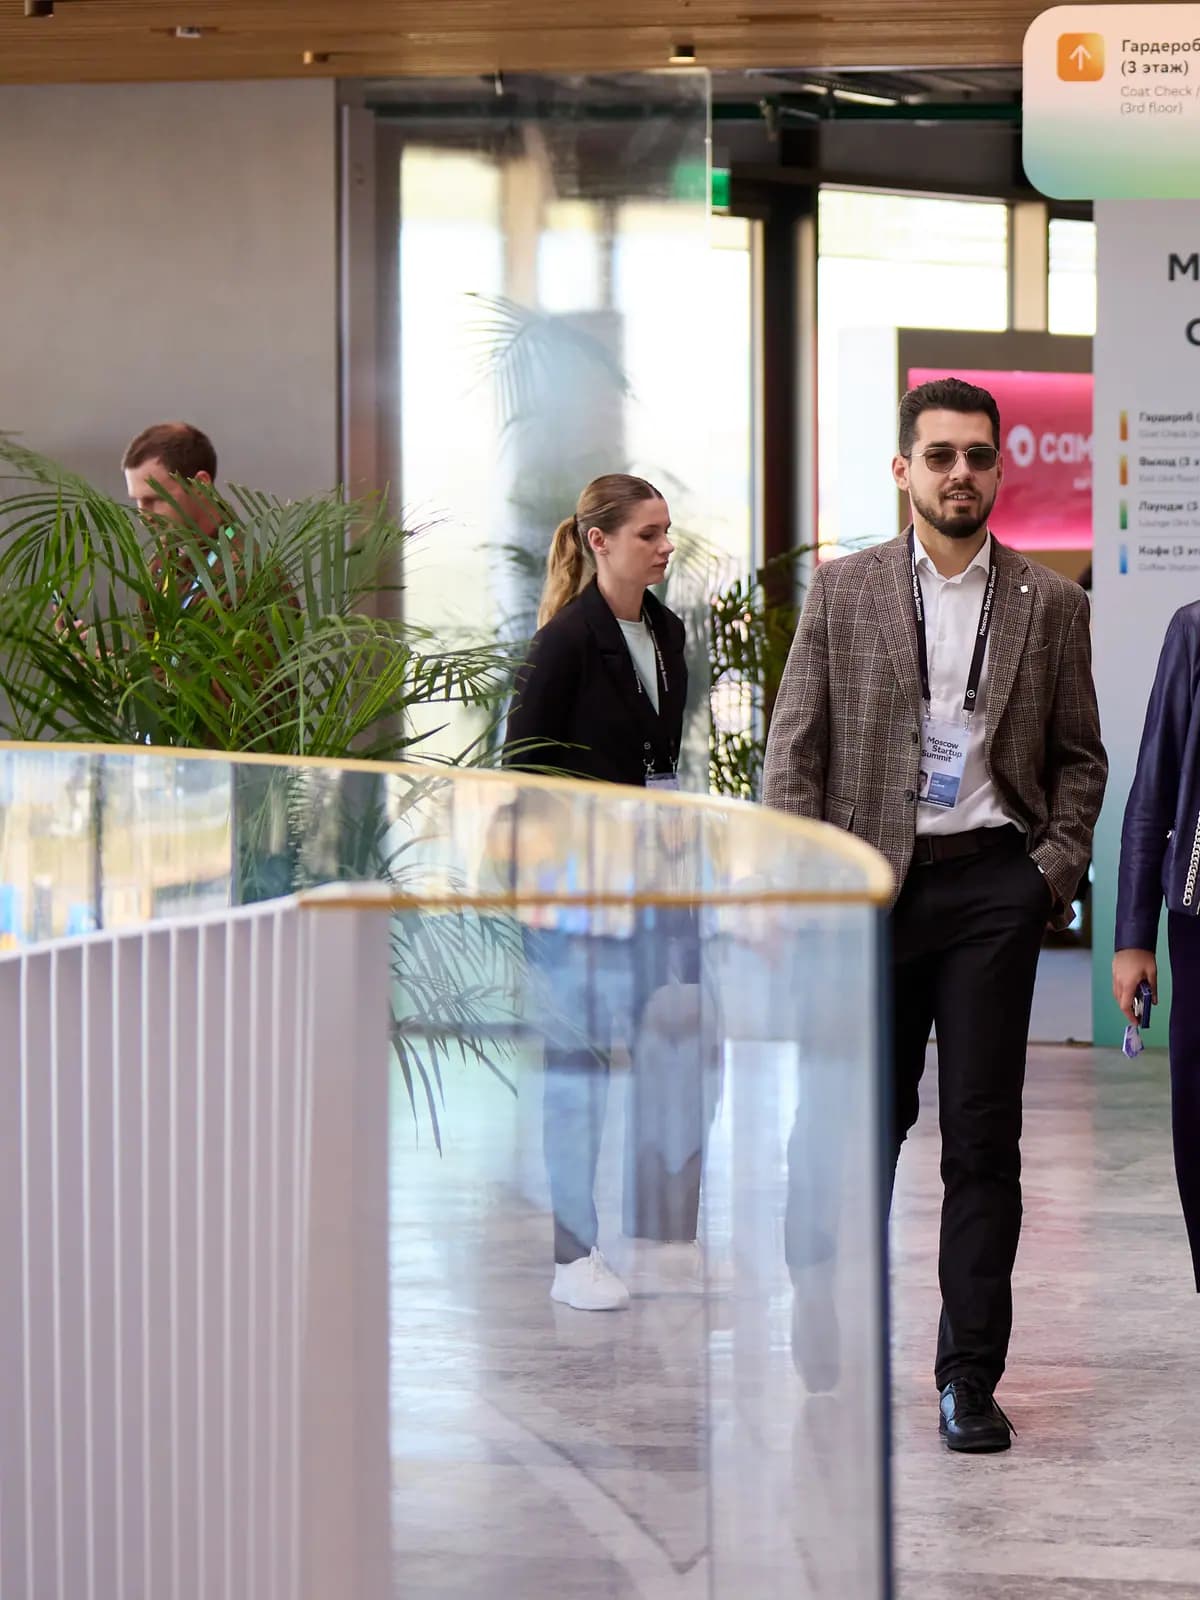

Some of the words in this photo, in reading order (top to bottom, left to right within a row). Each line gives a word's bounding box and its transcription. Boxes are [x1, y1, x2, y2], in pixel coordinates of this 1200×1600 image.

[1120, 60, 1137, 77] (3
[1142, 60, 1189, 76] этаж)
[1120, 86, 1150, 98] Coat
[1154, 85, 1192, 97] Check
[1120, 102, 1145, 115] (3rd
[1149, 102, 1183, 115] floor)
[927, 736, 959, 749] Moscow
[921, 749, 952, 762] Summit
[932, 744, 962, 758] Startup
